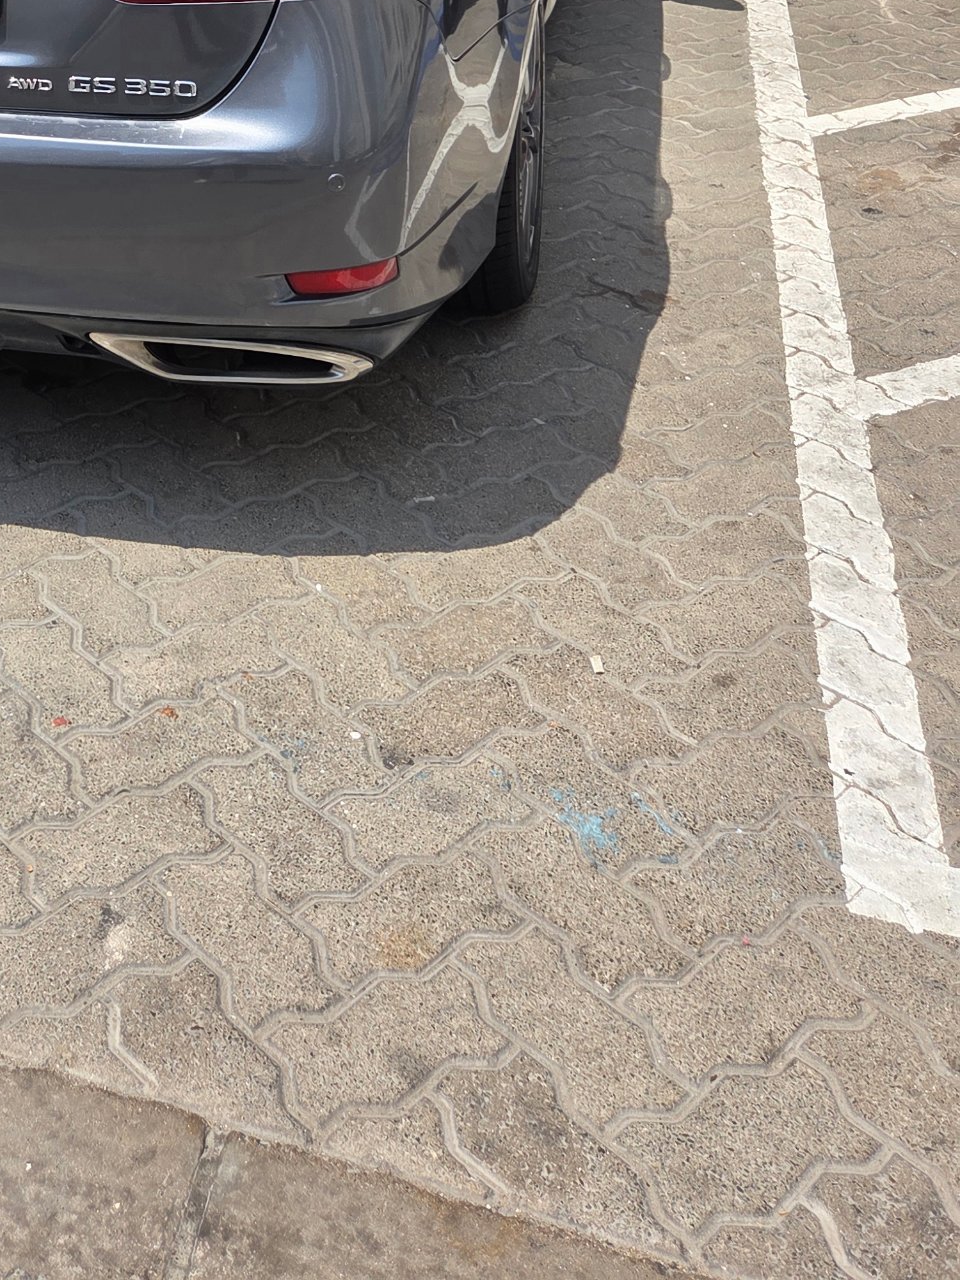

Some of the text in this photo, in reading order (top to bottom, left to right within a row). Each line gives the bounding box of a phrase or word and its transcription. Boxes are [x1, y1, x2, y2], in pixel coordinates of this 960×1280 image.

[7, 75, 197, 97] AWD GS 350
